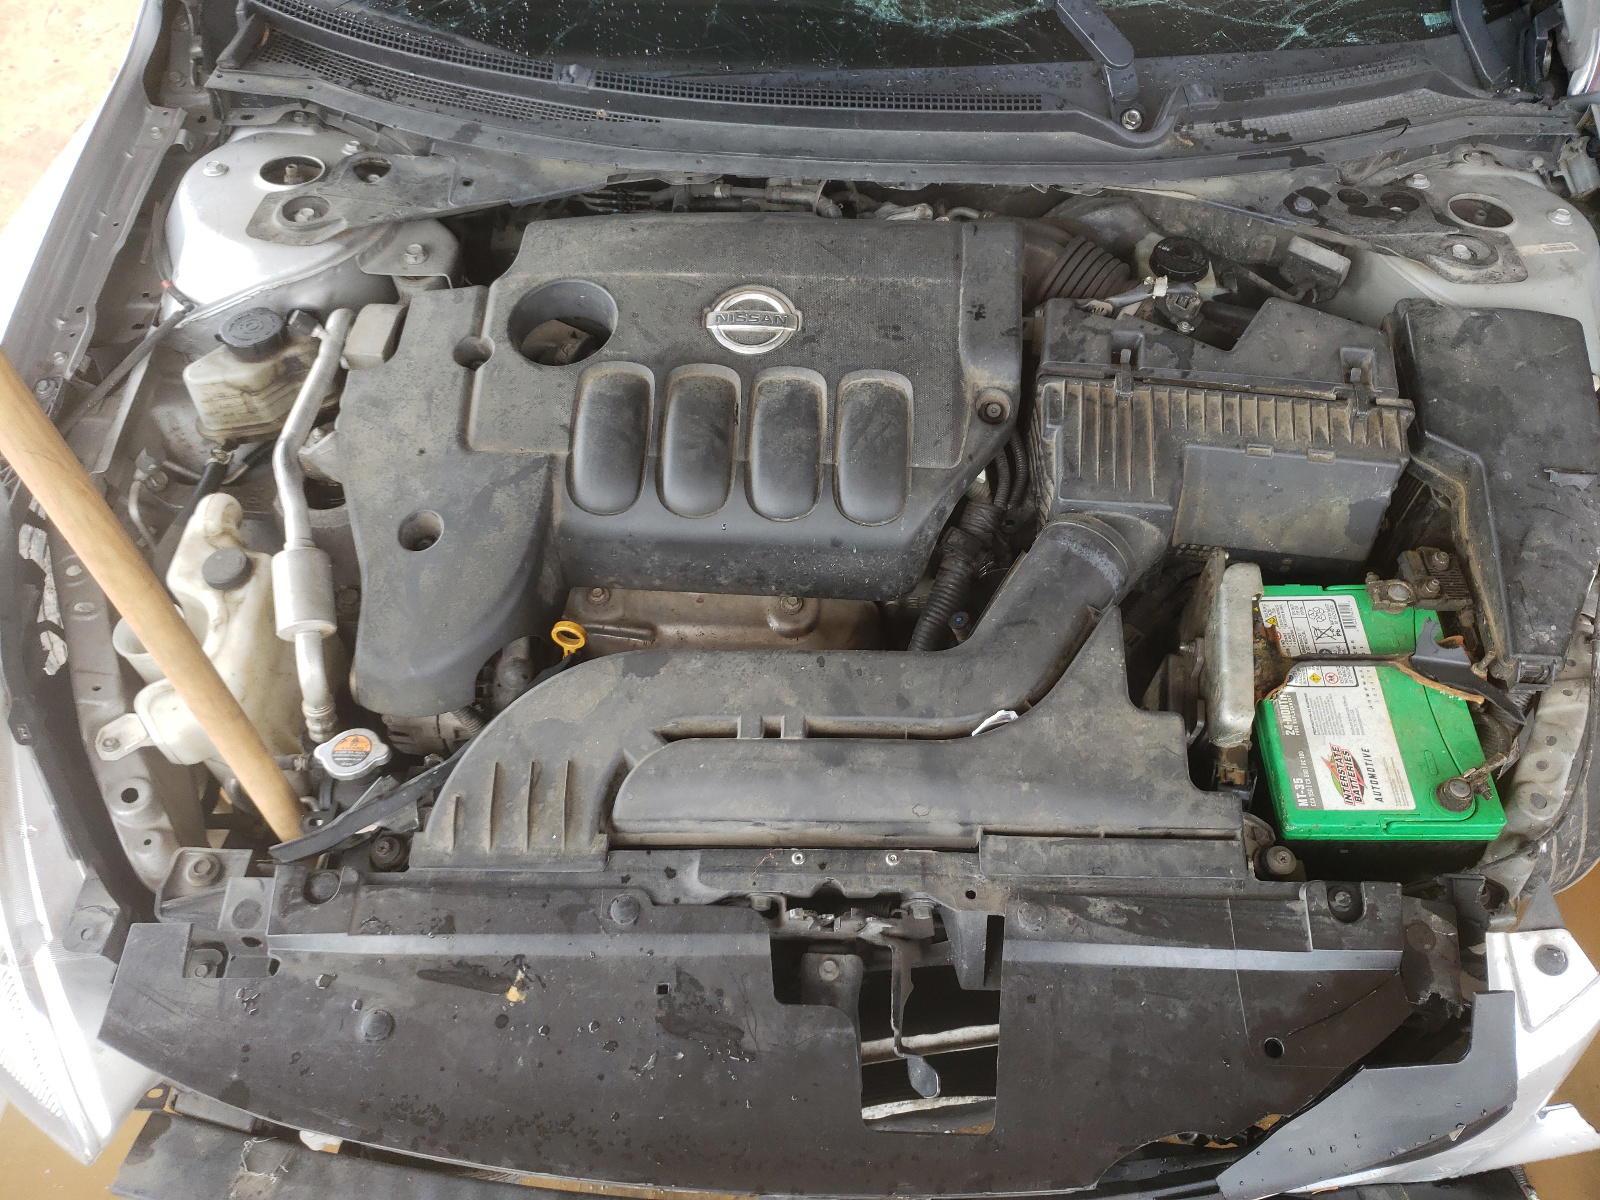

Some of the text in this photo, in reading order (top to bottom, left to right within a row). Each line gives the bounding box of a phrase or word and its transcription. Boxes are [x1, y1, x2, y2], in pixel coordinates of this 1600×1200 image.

[715, 313, 787, 325] NISSAN
[1292, 778, 1308, 806] MT-35
[1332, 746, 1354, 805] INTERSTATE
[1343, 751, 1363, 803] BATTERIES
[1361, 746, 1384, 802] AUTOMOTIVE
